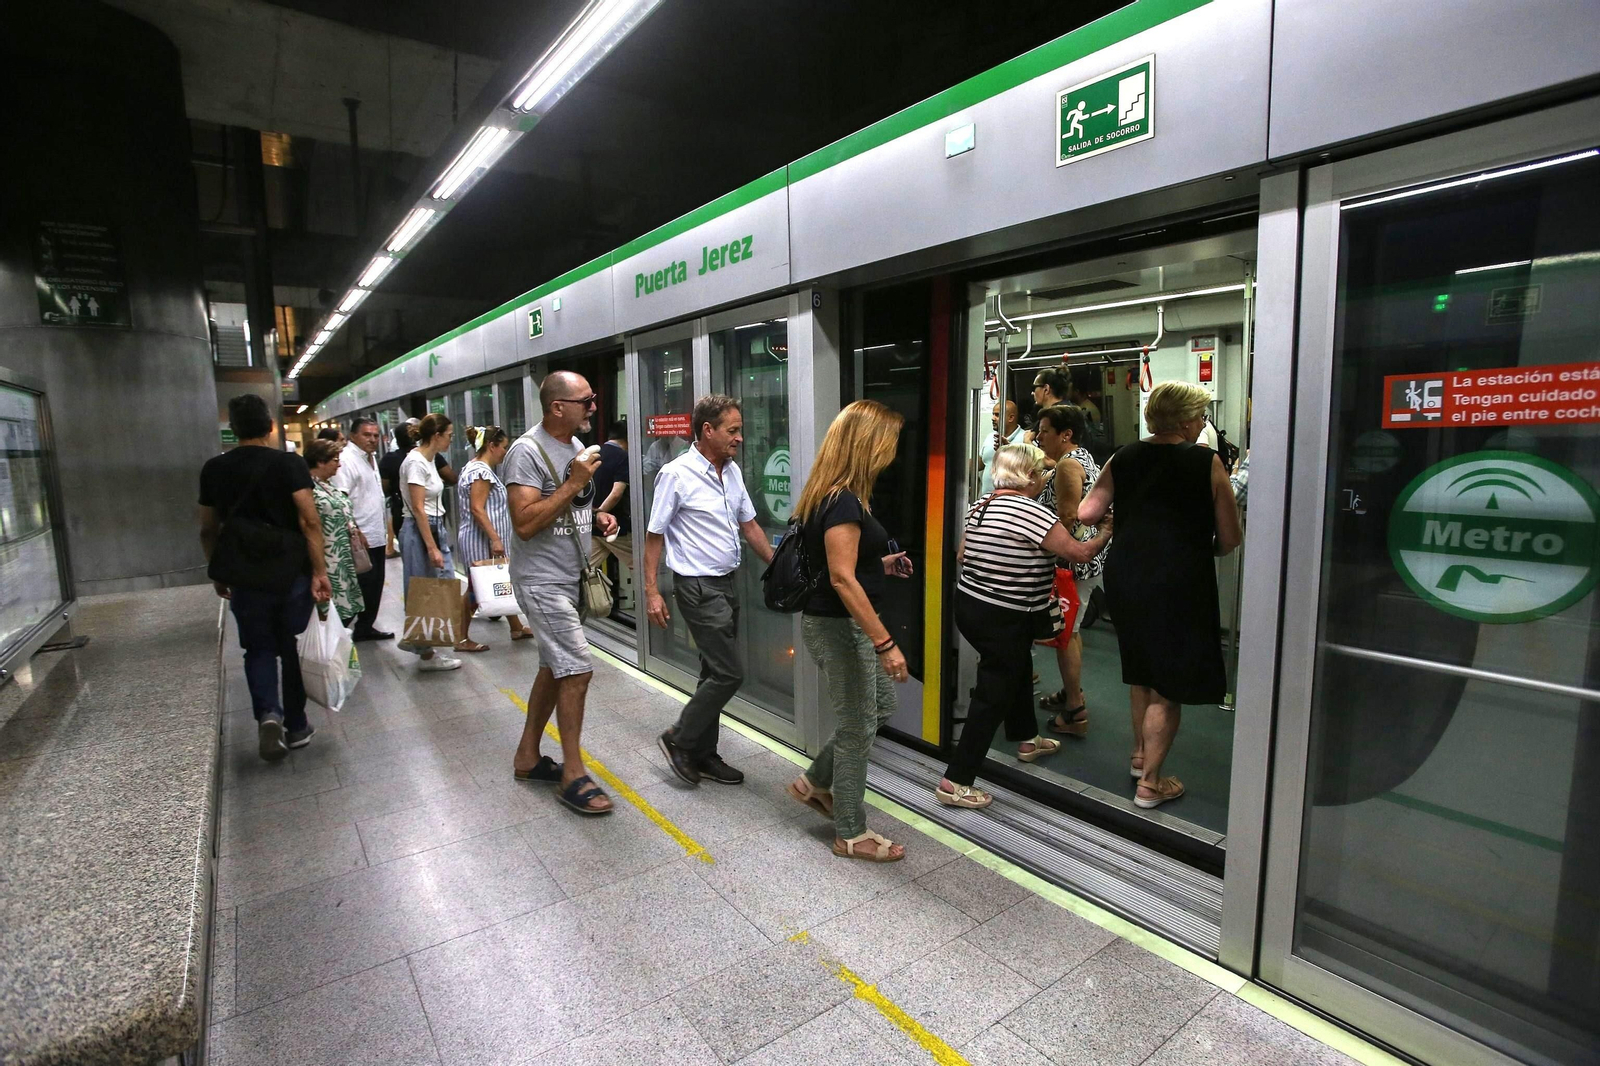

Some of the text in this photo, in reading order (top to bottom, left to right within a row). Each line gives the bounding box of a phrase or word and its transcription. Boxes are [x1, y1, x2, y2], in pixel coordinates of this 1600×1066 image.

[1068, 124, 1140, 153] SALIDA DE SOCORRO
[635, 234, 753, 298] Puerta Jerez
[813, 293, 821, 307] 6
[1452, 366, 1600, 388] La estación está
[1452, 388, 1596, 407] Tengan cuidado
[1451, 405, 1600, 424] el pie entre coch
[1421, 518, 1566, 558] Metro
[402, 615, 456, 643] ZARA
